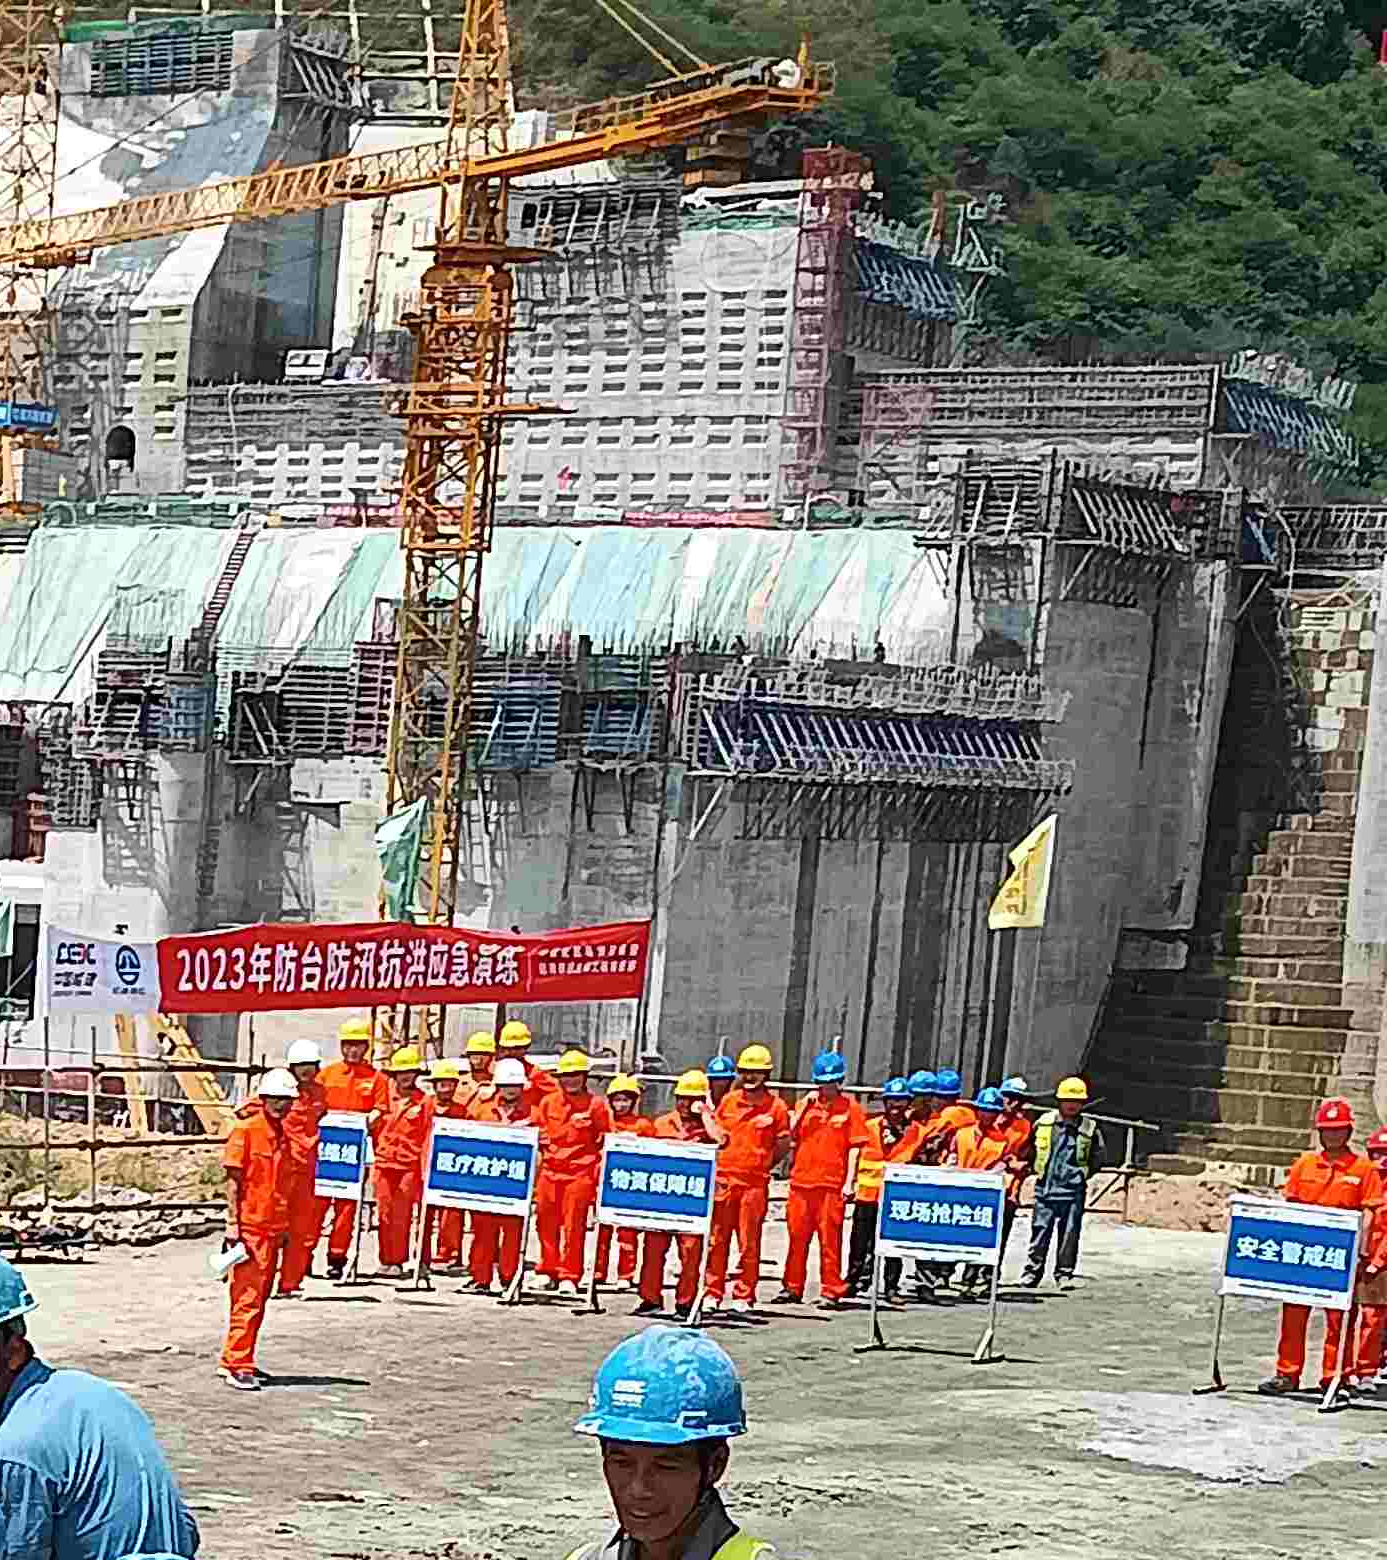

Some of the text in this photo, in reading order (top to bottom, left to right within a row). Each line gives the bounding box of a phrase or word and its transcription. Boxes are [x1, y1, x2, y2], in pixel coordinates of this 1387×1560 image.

[436, 1151, 527, 1181] 医疗救护组
[610, 1168, 707, 1198] 物资保障组
[889, 1200, 994, 1228] 现场抢险组
[1236, 1236, 1347, 1271] 安全警戒组
